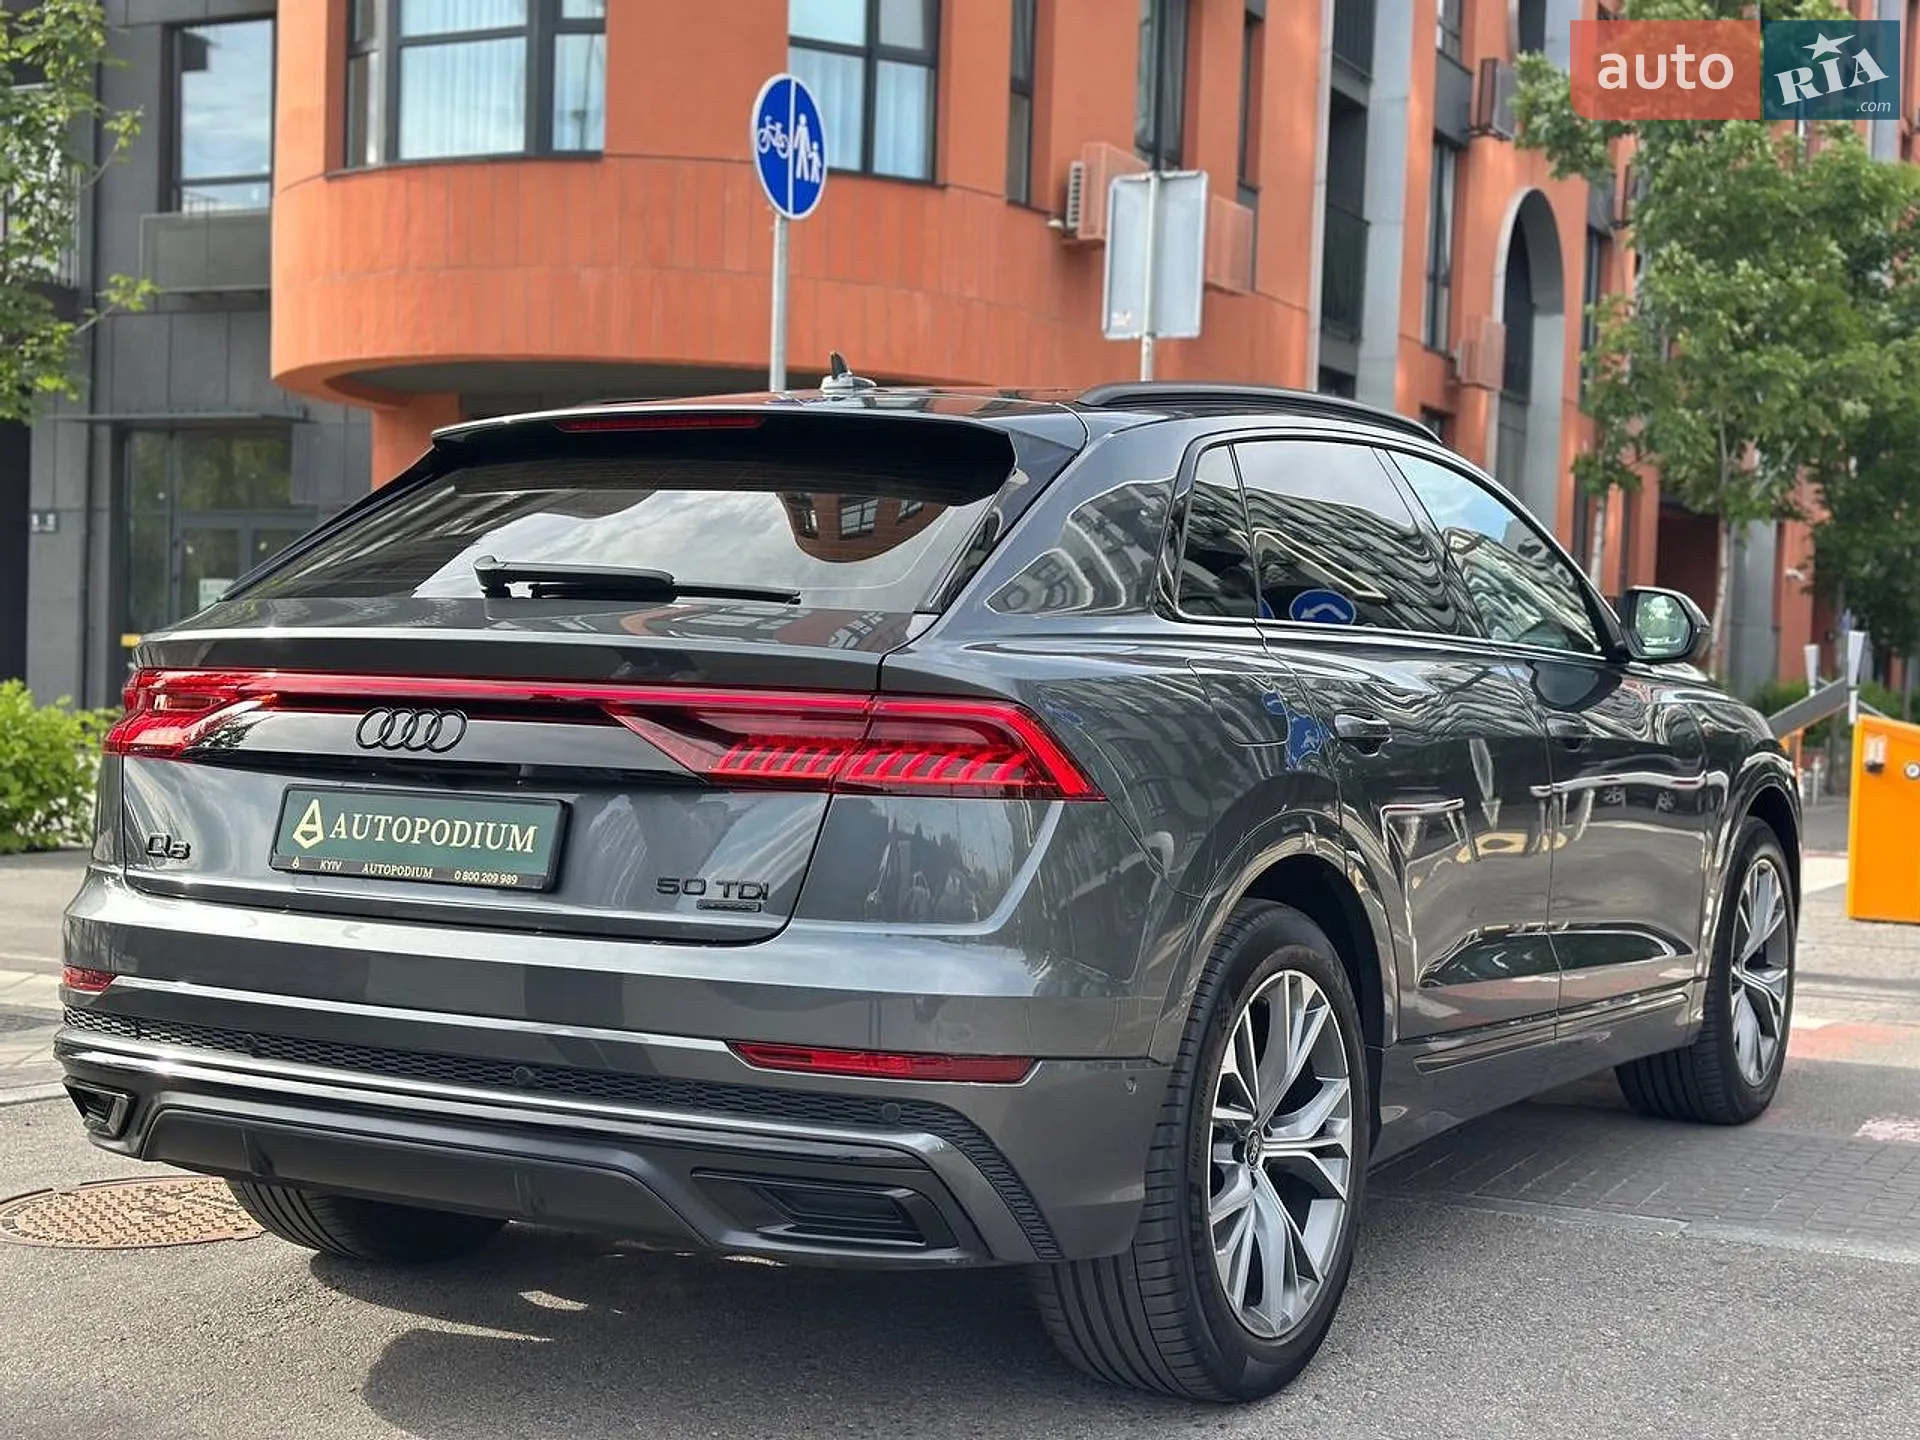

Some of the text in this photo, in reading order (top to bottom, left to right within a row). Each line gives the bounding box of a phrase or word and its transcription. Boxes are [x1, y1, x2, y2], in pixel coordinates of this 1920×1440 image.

[329, 812, 538, 853] AUTOPODIUM
[146, 832, 191, 860] Q8
[320, 859, 342, 872] KYIV
[361, 863, 433, 879] AUTOPODIUM
[454, 869, 461, 881] 0
[462, 870, 480, 883] 800
[481, 872, 499, 884] 209
[656, 877, 769, 900] 50 TDI
